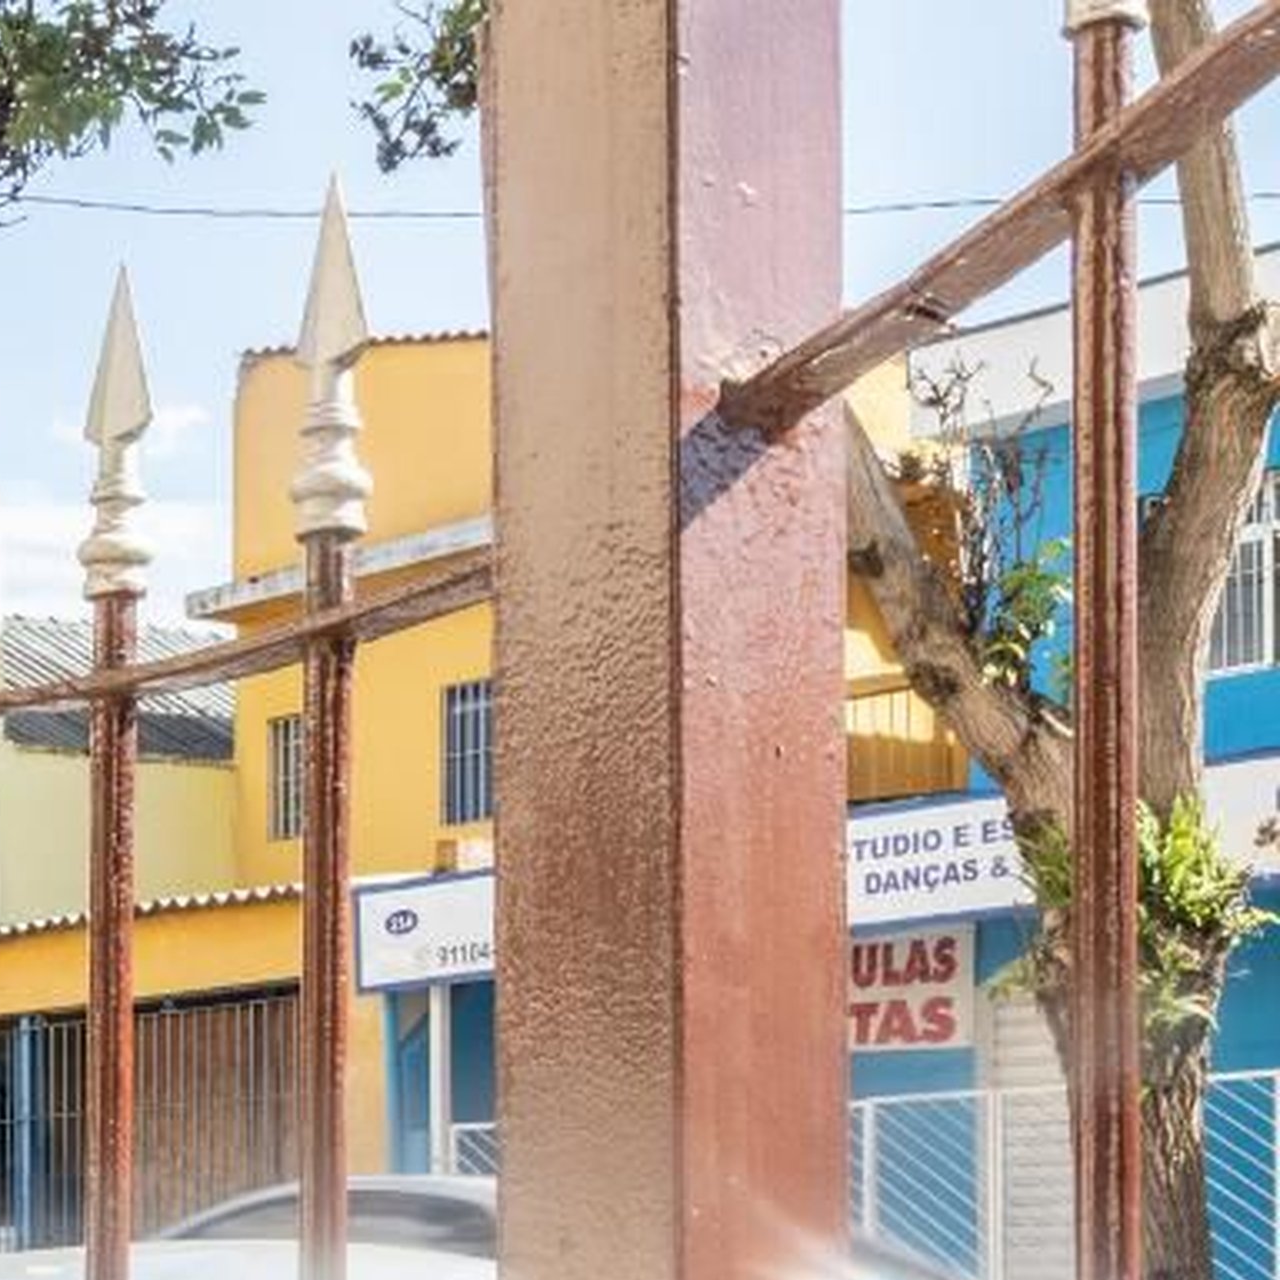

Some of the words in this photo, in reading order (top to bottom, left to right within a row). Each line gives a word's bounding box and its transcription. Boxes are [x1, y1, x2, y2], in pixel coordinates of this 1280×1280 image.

[953, 825, 971, 847] E
[865, 858, 979, 895] DANÇAS
[990, 855, 1009, 878] &
